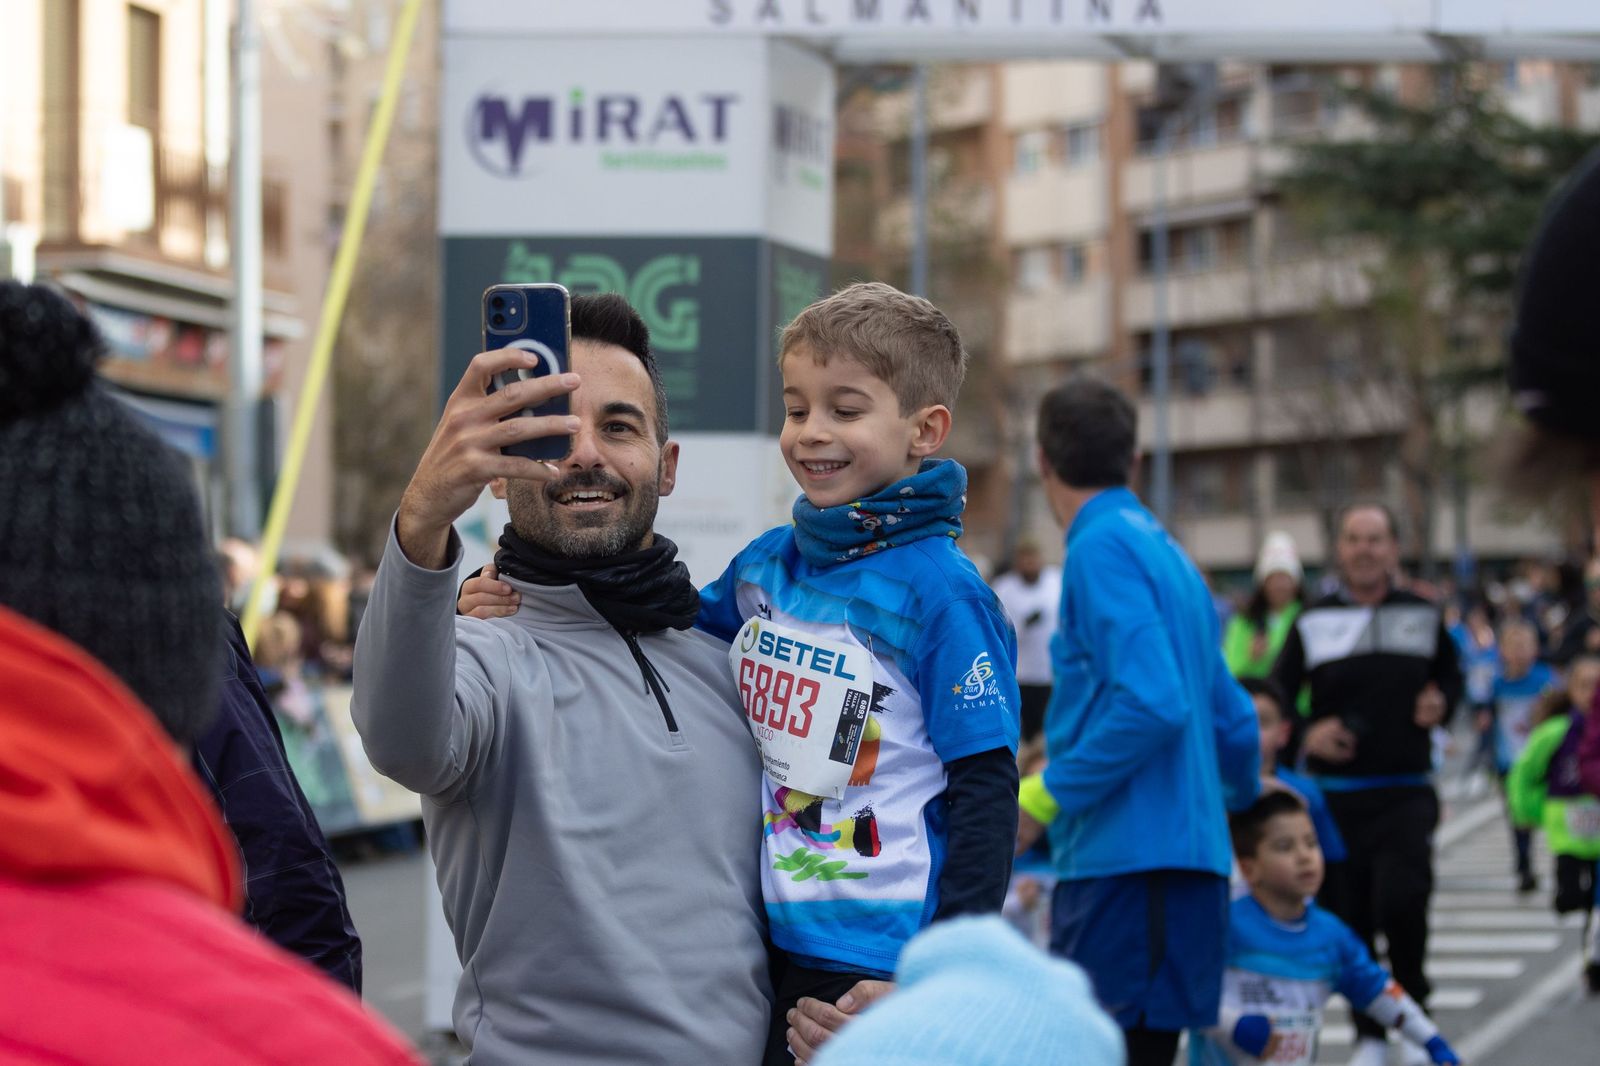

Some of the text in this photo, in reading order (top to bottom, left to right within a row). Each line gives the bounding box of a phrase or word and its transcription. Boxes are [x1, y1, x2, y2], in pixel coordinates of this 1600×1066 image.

[758, 630, 856, 682] SETEL
[739, 657, 821, 739] 6893
[845, 690, 853, 707] TALLA
[857, 699, 868, 720] 6893
[757, 725, 774, 742] NICO
